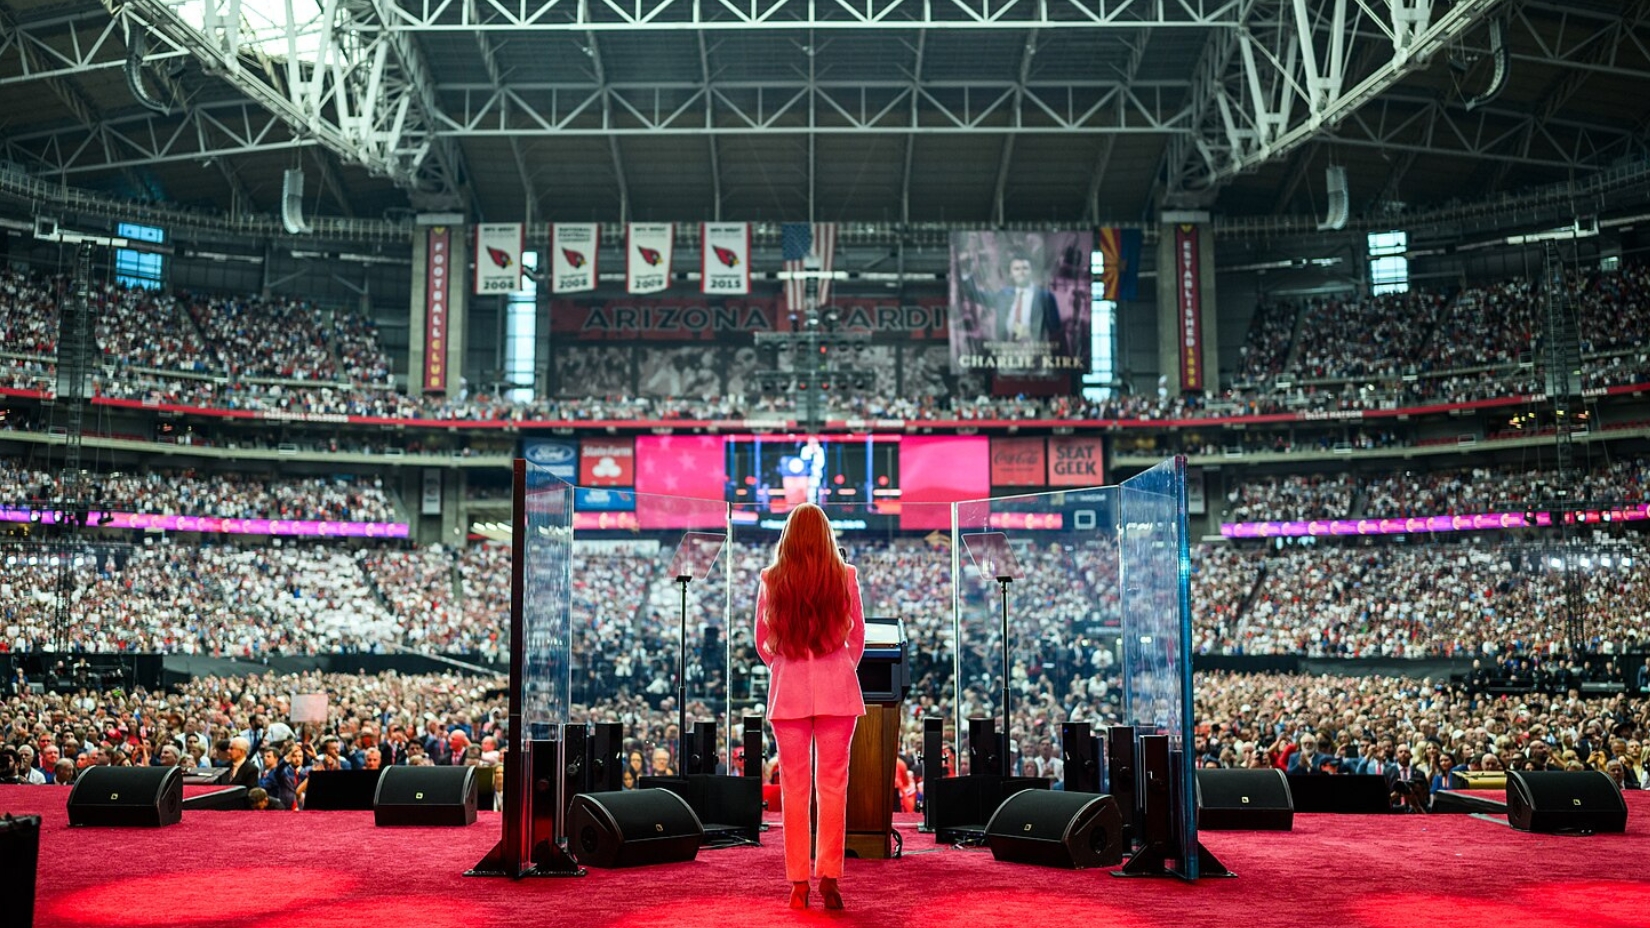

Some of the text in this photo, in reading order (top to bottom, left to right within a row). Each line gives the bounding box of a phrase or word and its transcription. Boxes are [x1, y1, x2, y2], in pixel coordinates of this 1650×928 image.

[484, 281, 515, 289] 2008
[710, 280, 741, 289] 2015
[1183, 240, 1195, 347] ESTABLISHED
[430, 241, 444, 388] FOOTBALL CLUB
[582, 305, 948, 331] ARIZONA CARDI
[959, 354, 1084, 369] CHARLIE KIRK
[1581, 387, 1608, 397] LIAMS
[1056, 445, 1095, 460] SEAT
[1054, 460, 1097, 476] GEEK
